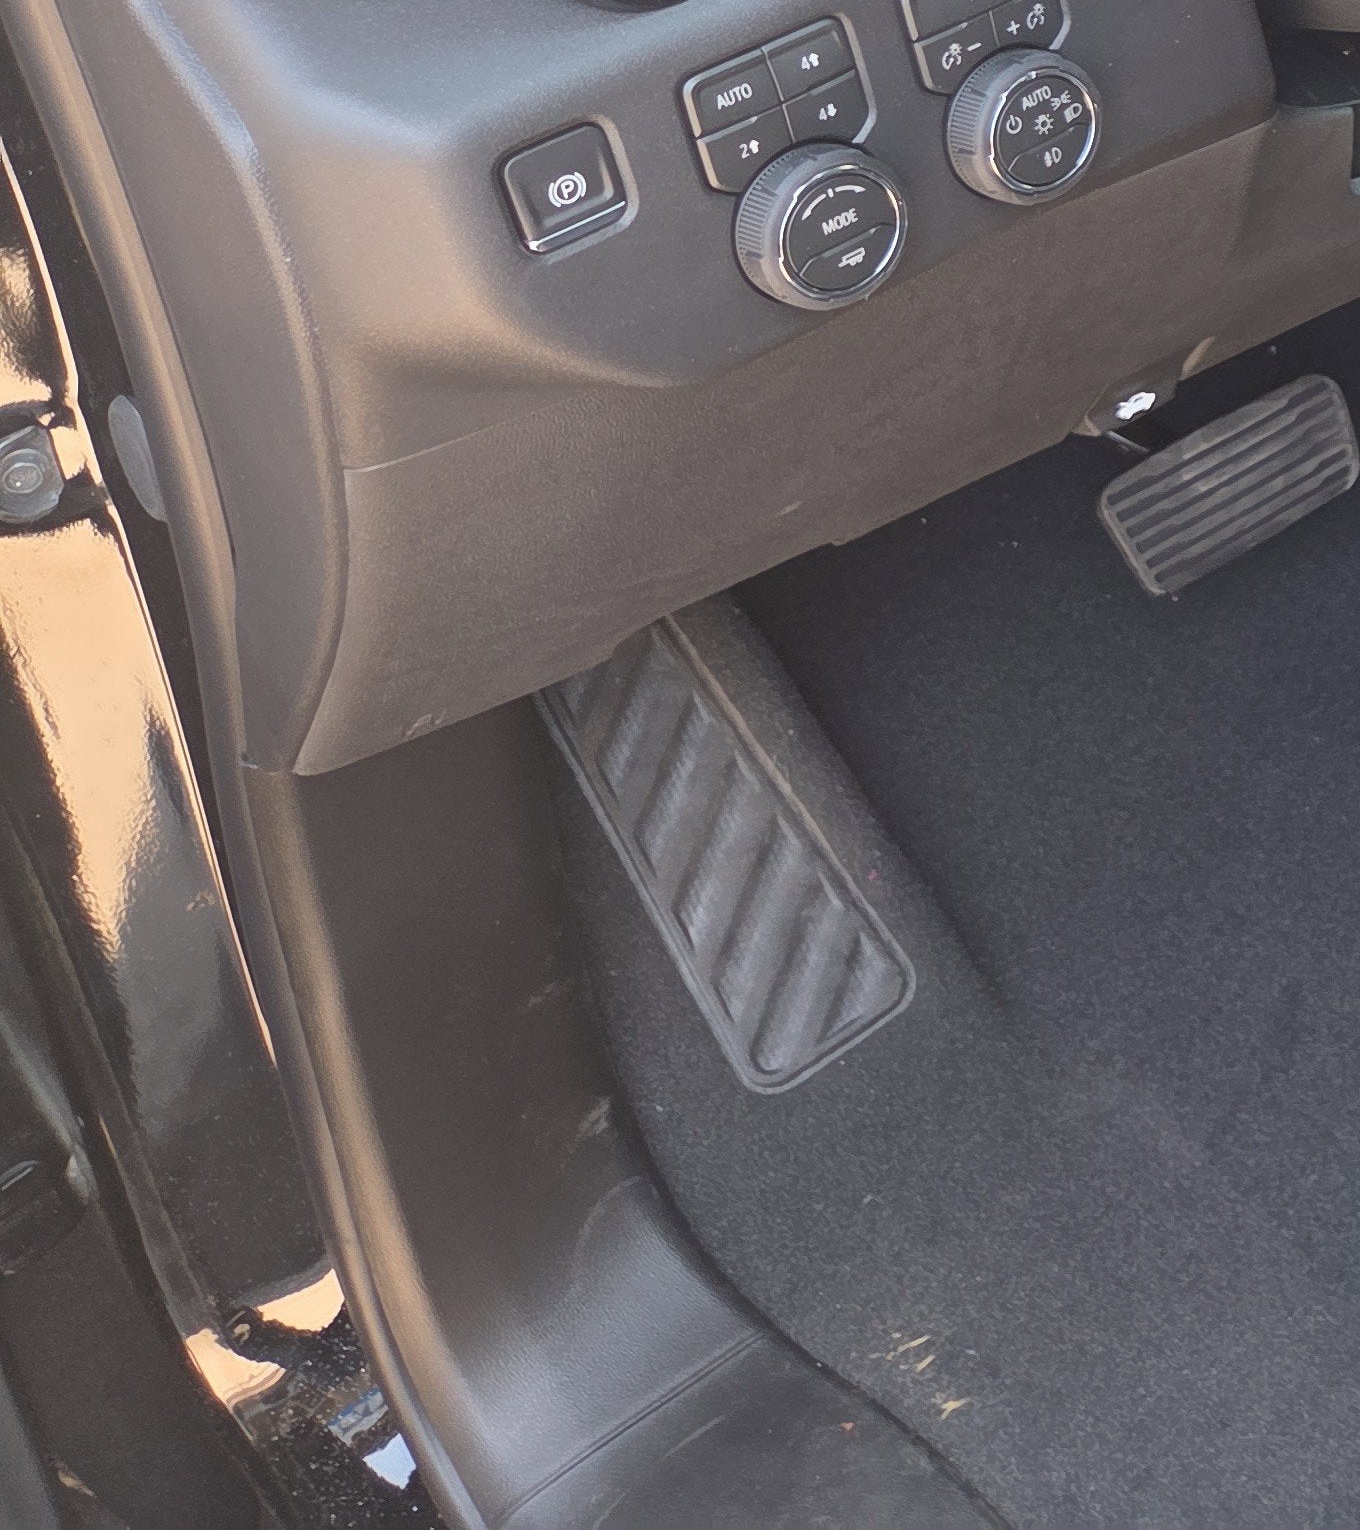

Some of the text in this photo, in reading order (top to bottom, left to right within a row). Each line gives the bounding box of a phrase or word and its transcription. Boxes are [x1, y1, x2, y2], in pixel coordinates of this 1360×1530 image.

[716, 83, 753, 110] AUTO
[1022, 85, 1052, 111] AUTO
[822, 207, 859, 236] MODE
